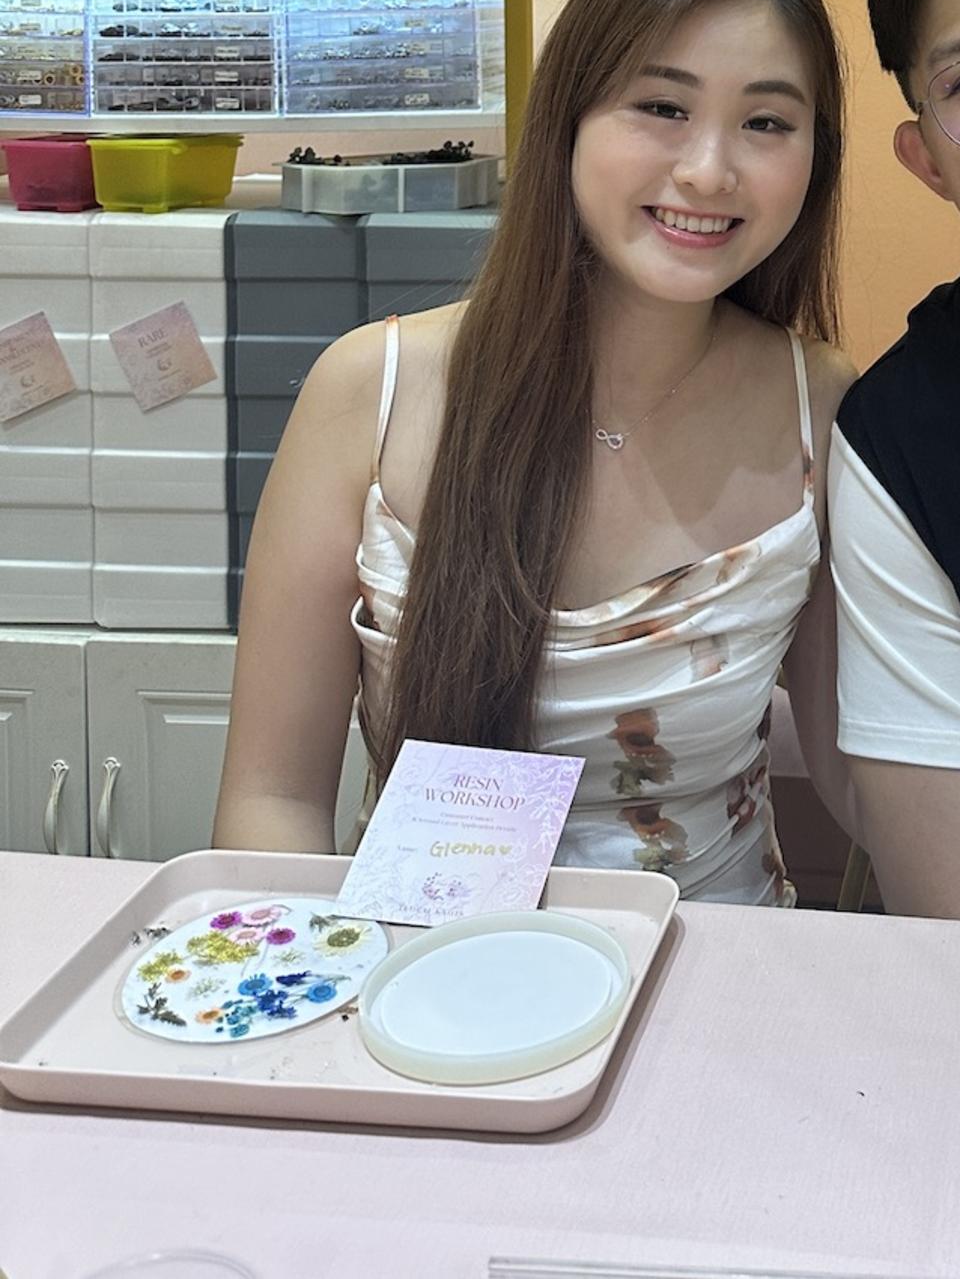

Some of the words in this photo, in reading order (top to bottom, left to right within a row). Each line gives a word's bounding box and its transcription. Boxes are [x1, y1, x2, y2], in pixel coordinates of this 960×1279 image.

[138, 328, 167, 349] RARE
[454, 774, 503, 791] RESIN
[426, 788, 525, 810] WORKSHOP
[430, 840, 496, 858] Glenna
